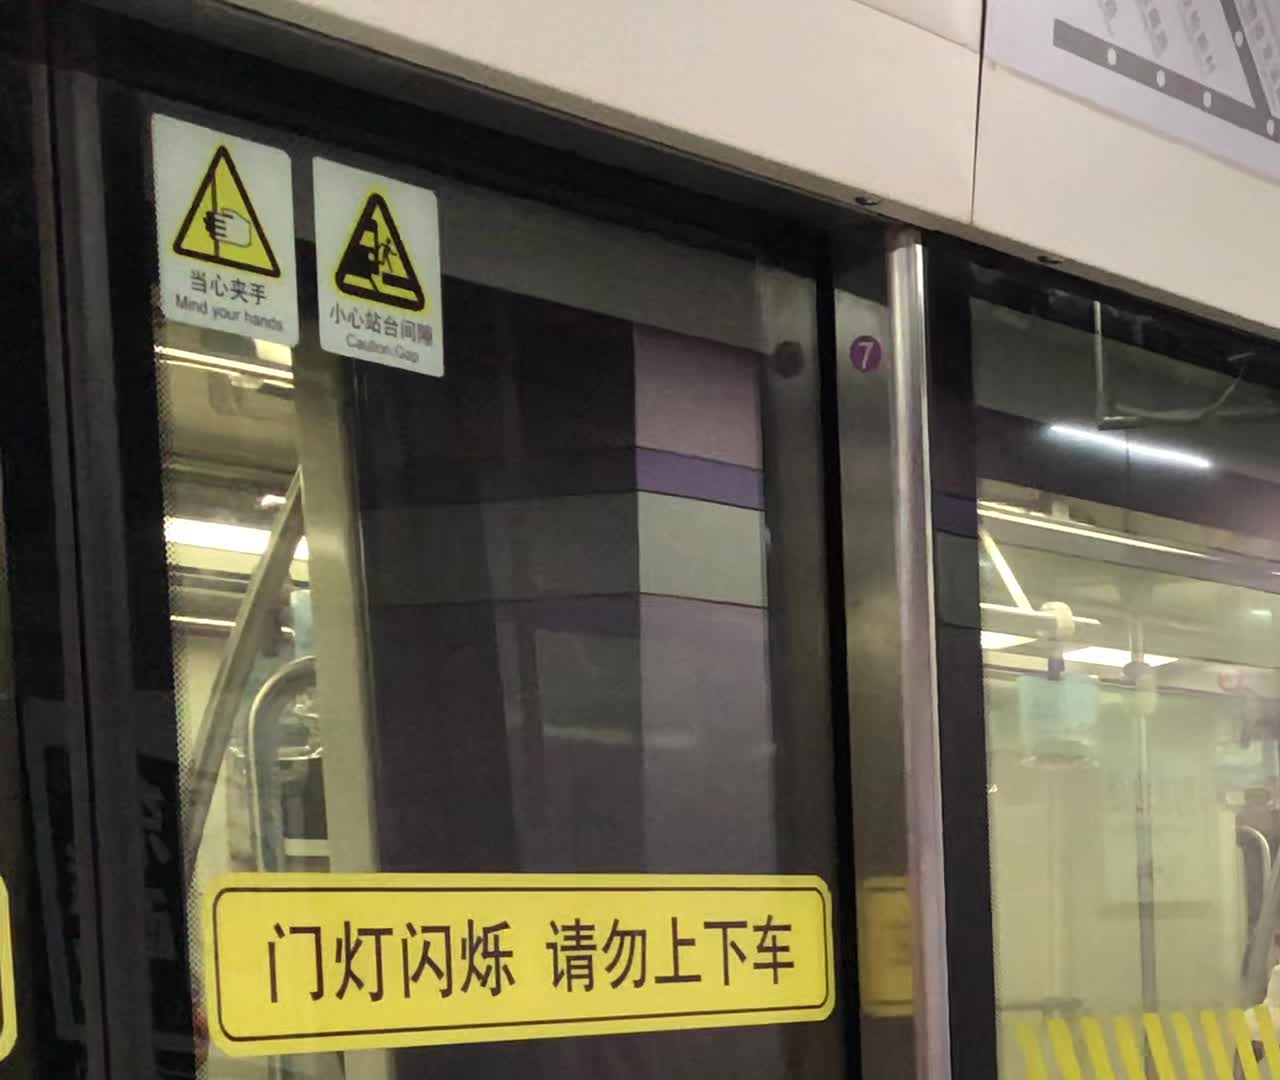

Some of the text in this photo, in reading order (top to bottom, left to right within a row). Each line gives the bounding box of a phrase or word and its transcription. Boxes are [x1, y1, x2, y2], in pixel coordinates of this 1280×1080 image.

[189, 268, 267, 306] 当心夹手
[175, 293, 284, 332] Mind your hands
[857, 341, 875, 370] 7
[267, 913, 796, 1003] 门灯闪烁 请勿上下车
